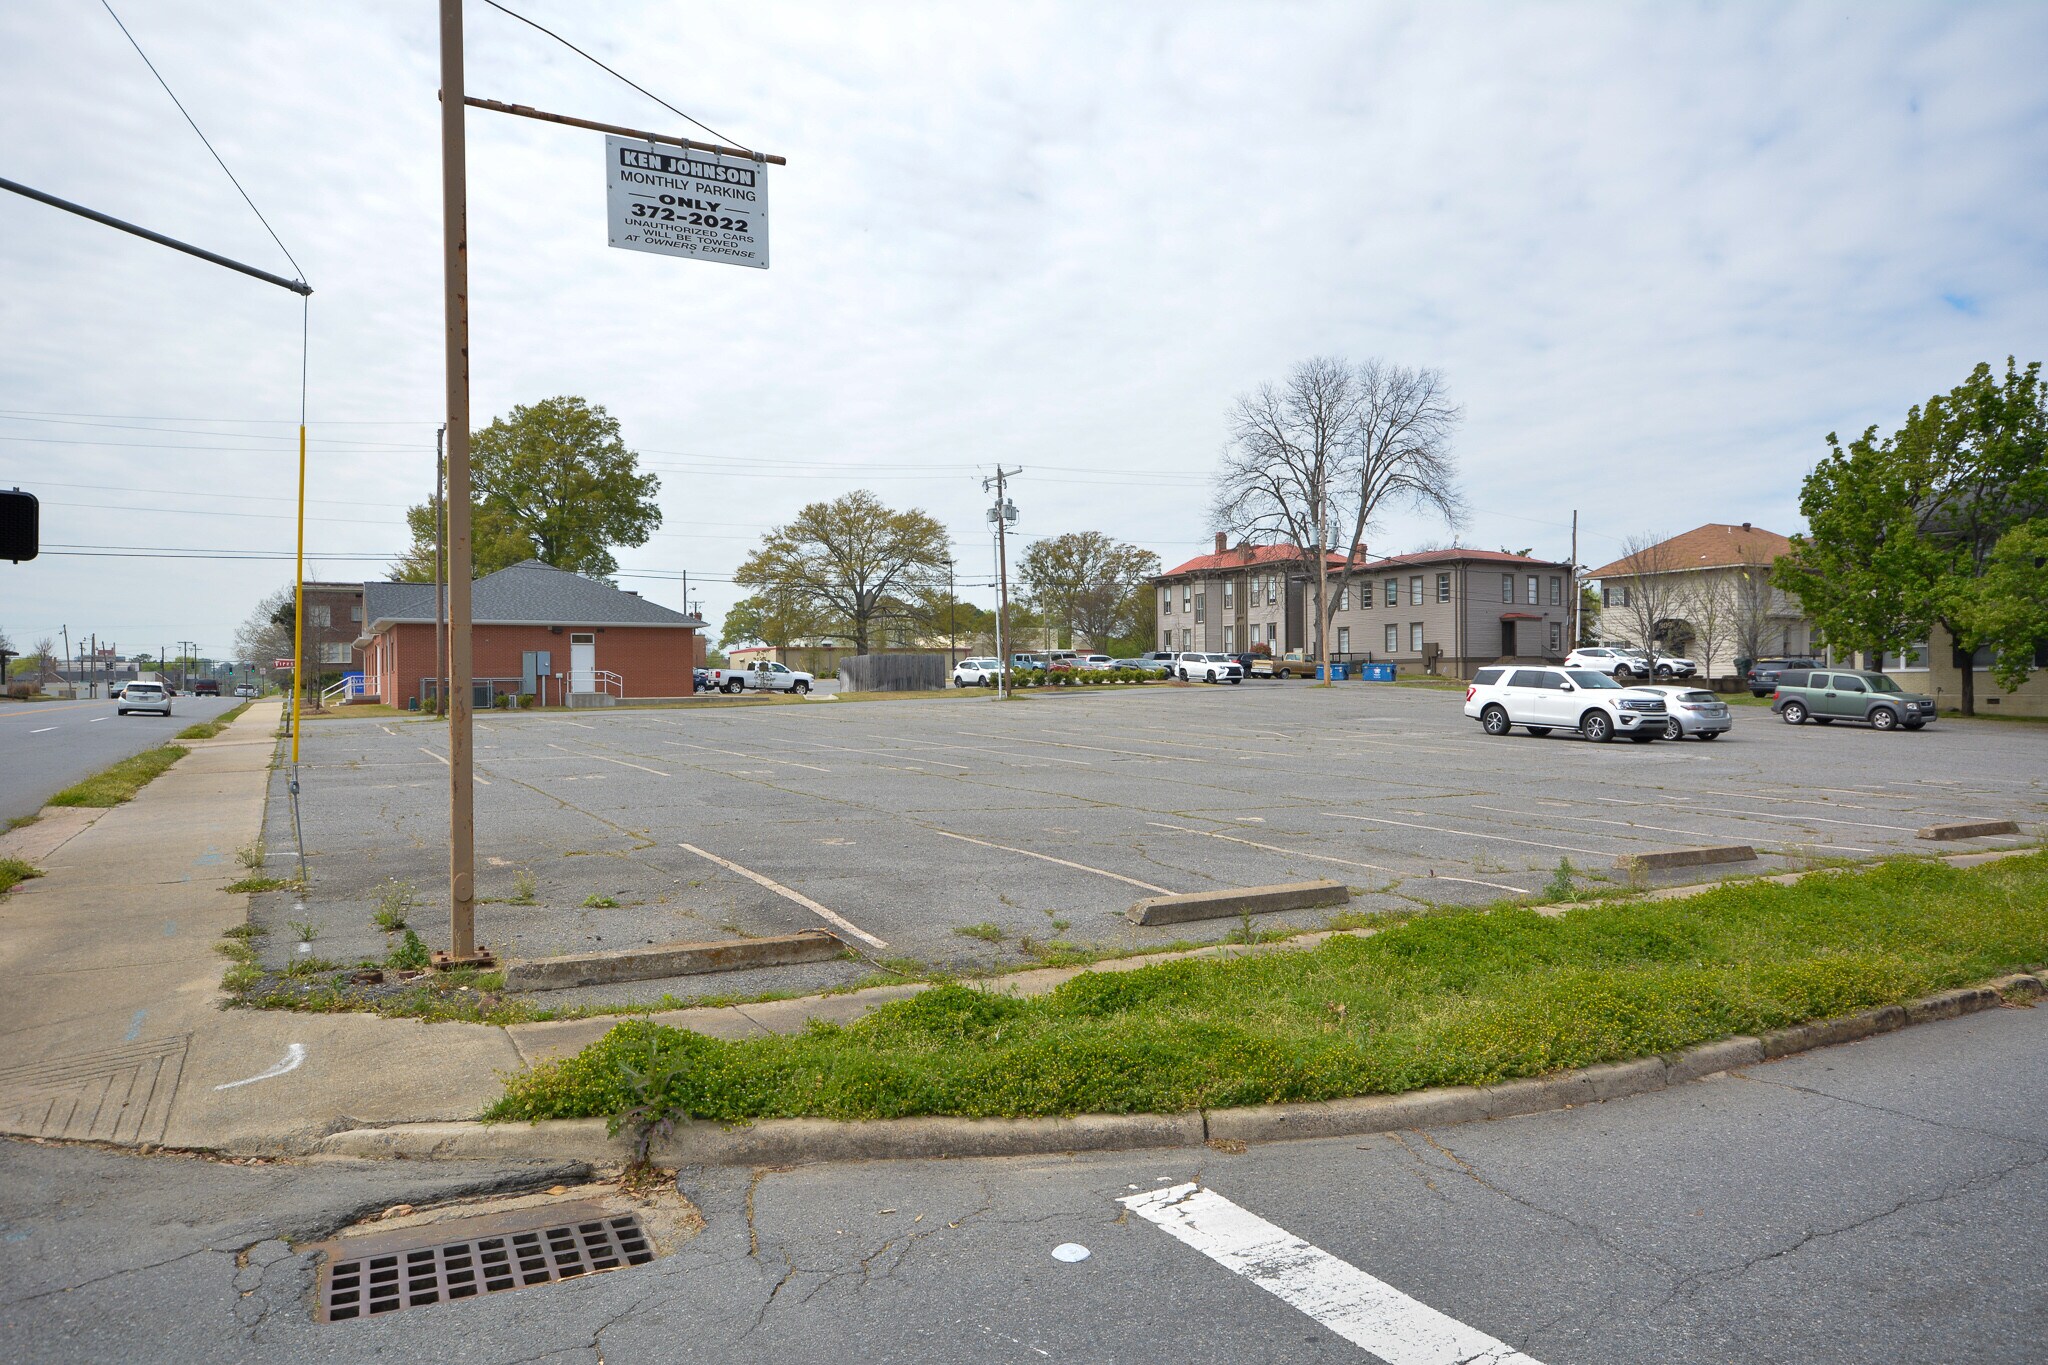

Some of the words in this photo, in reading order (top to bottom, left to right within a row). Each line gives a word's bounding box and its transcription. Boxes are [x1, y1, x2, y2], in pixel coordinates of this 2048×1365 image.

[624, 150, 662, 170] KEN
[667, 158, 752, 185] JOHNSON
[620, 170, 689, 190] MONTHLY
[696, 182, 756, 202] PARKING
[658, 194, 721, 213] ONLY
[624, 218, 718, 238] UNAUTHORIZED
[723, 232, 754, 243] CARS
[631, 203, 748, 233] 372-2022
[624, 234, 641, 242] AT
[644, 238, 698, 250] OWNERS
[701, 245, 756, 259] EXPENSE
[643, 228, 671, 239] WILL
[676, 234, 692, 242] BE
[697, 236, 738, 248] TOWED
